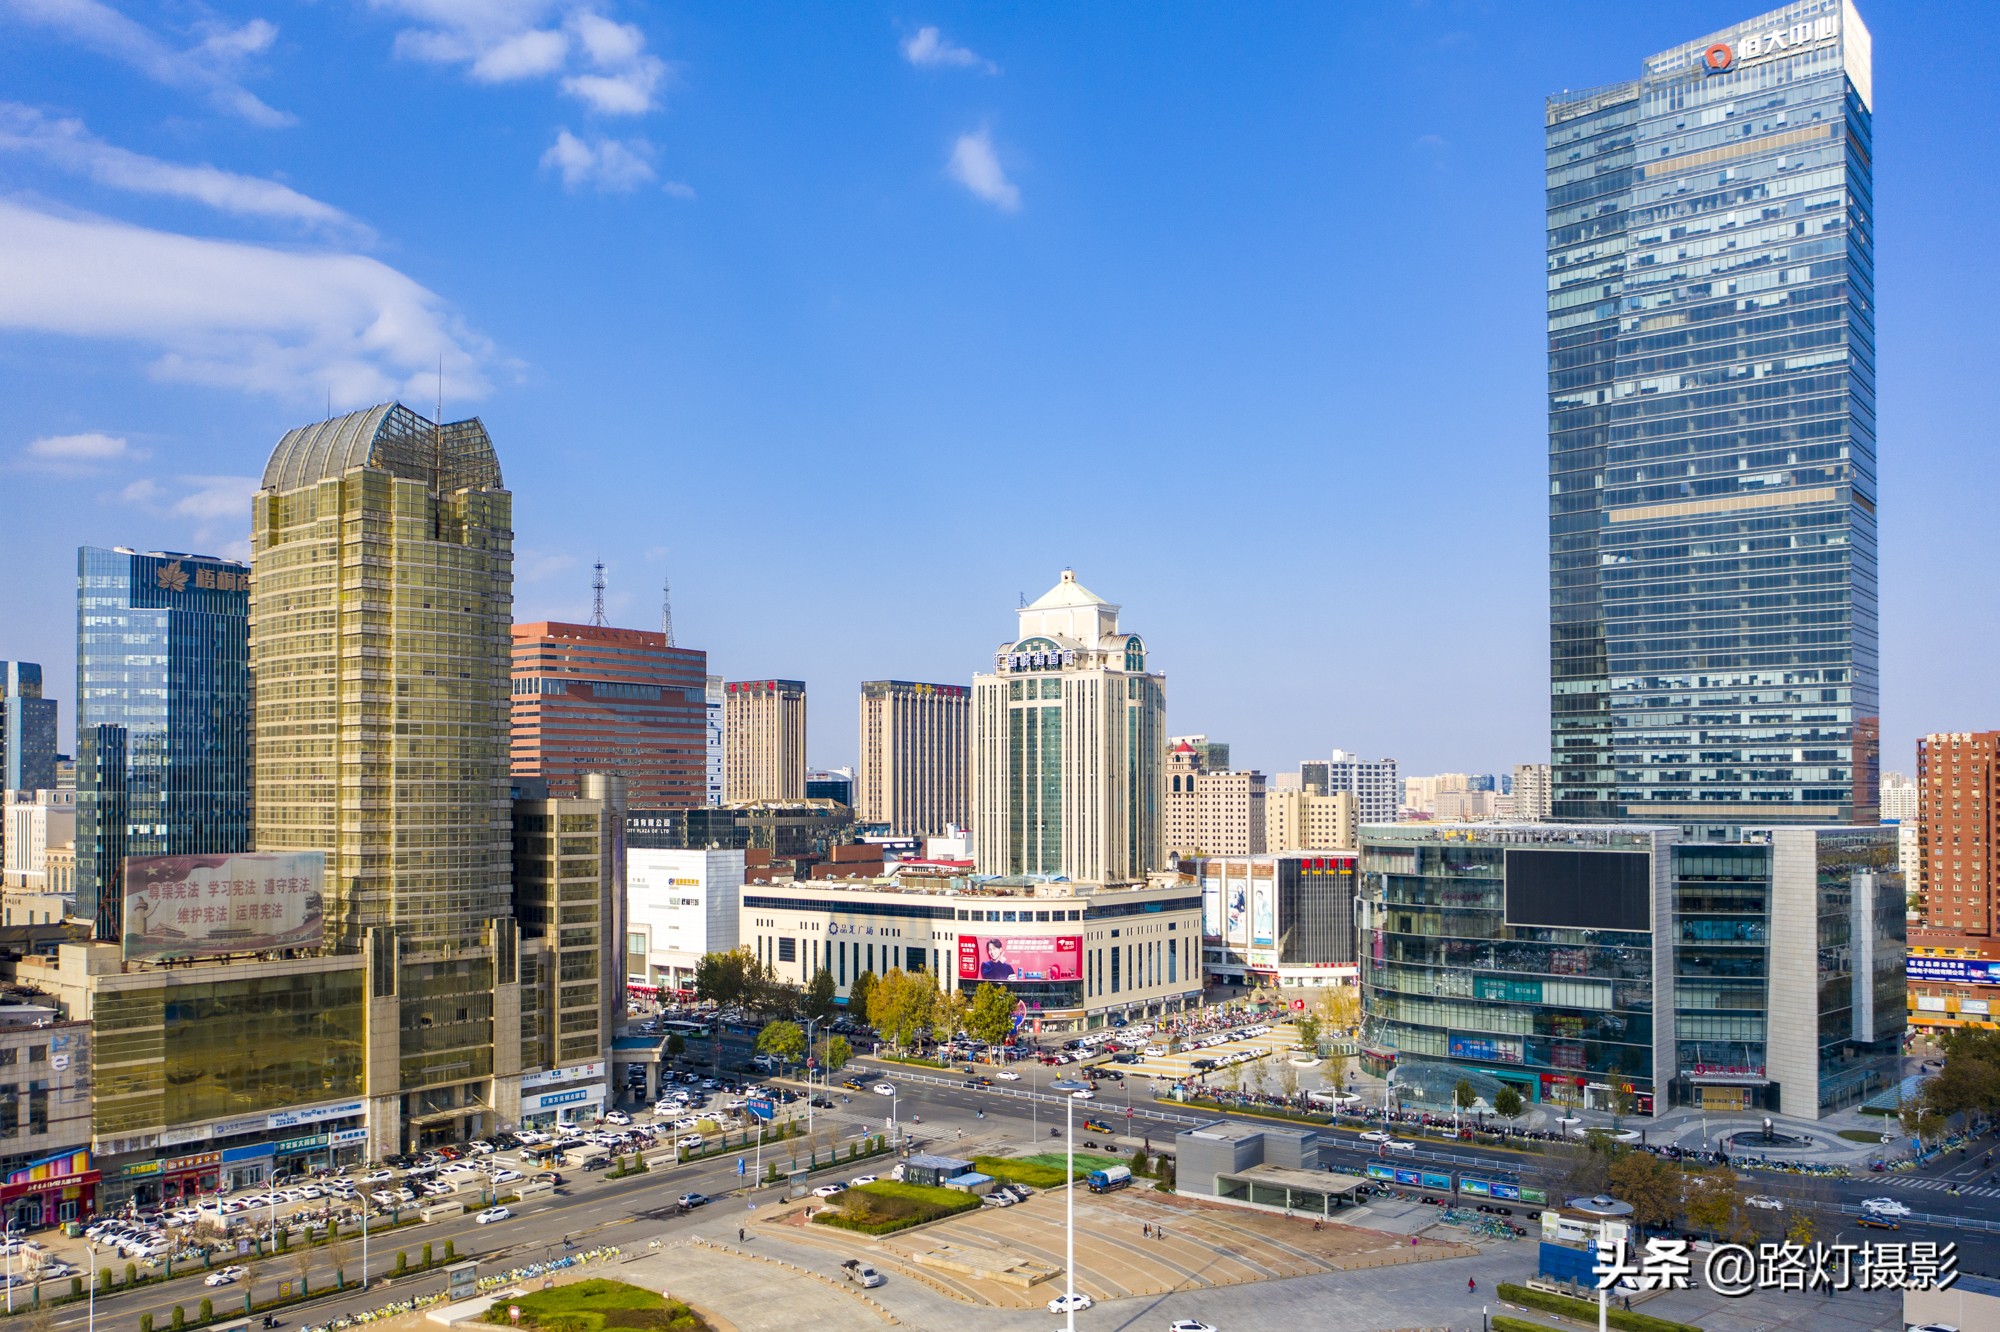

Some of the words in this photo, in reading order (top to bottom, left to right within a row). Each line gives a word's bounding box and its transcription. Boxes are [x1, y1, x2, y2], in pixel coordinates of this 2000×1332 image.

[1737, 15, 1838, 61] 恒大中心
[147, 880, 199, 900] 尊崇宪法
[208, 878, 256, 897] 学习宪法
[264, 876, 310, 895] 遵守宪法
[177, 905, 228, 924] 维护宪法
[235, 902, 283, 921] 运用宪法
